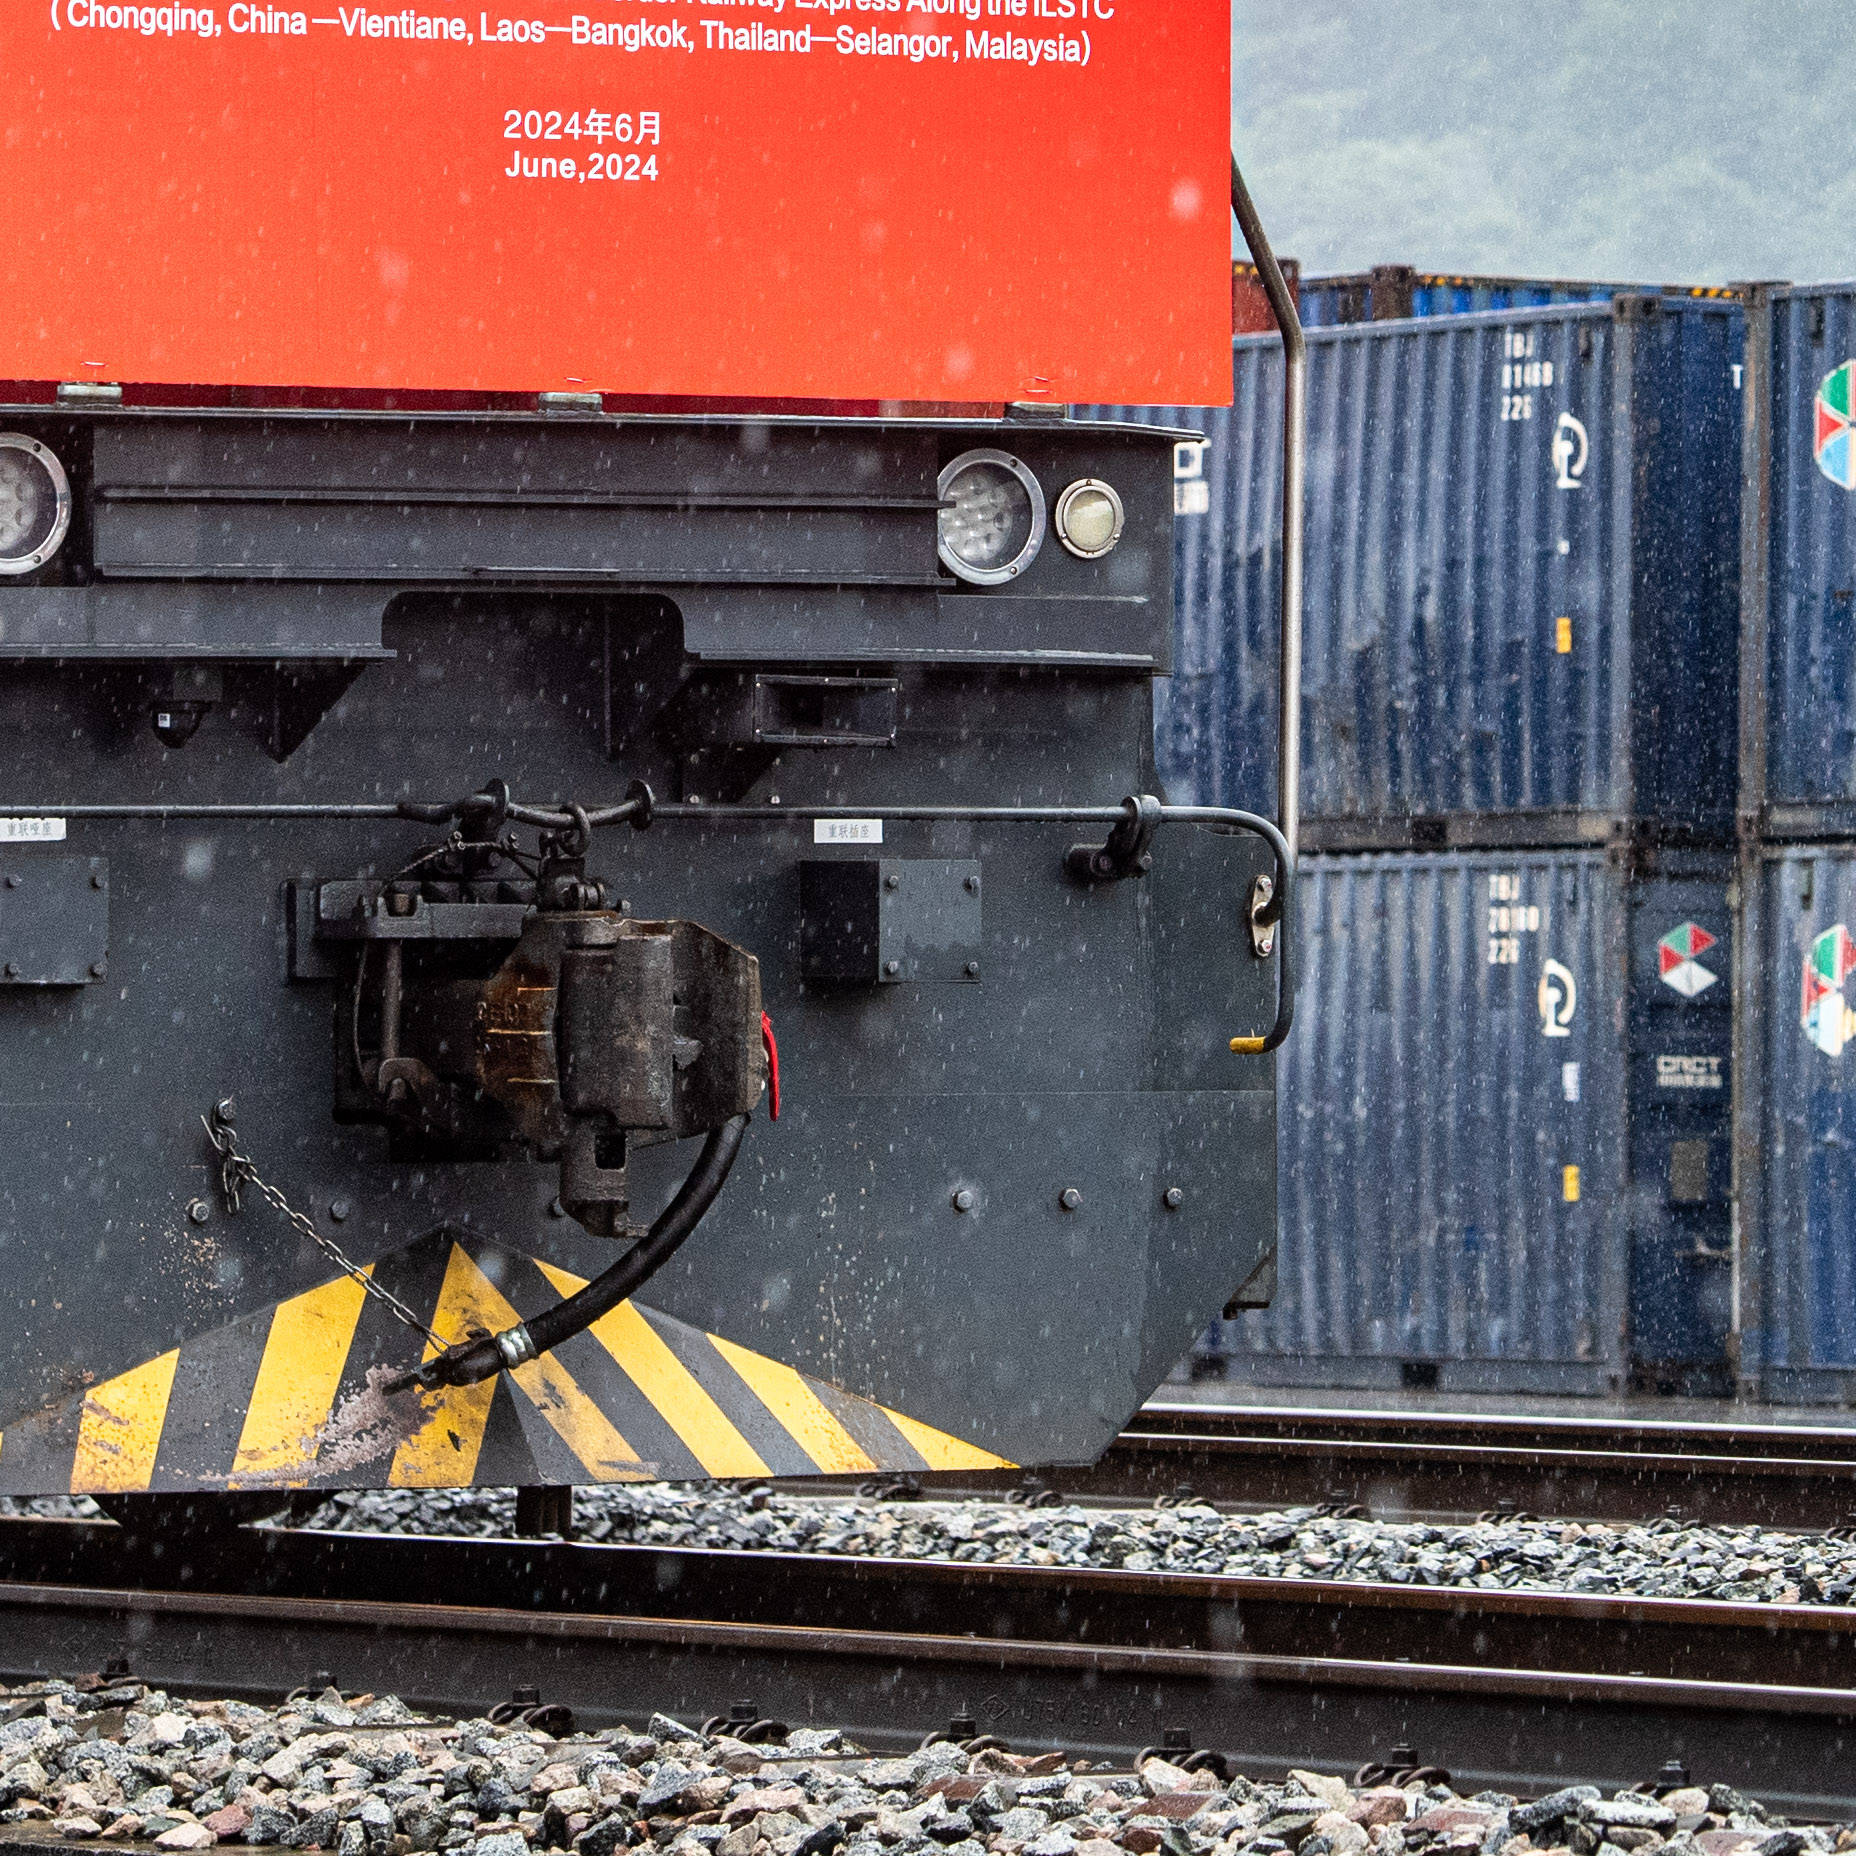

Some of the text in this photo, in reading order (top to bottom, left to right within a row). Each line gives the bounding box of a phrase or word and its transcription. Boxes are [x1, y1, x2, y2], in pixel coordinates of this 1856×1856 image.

[965, 28, 1091, 67] Malaysia)
[503, 107, 661, 145] 2024年6月
[504, 150, 659, 184] June,2024
